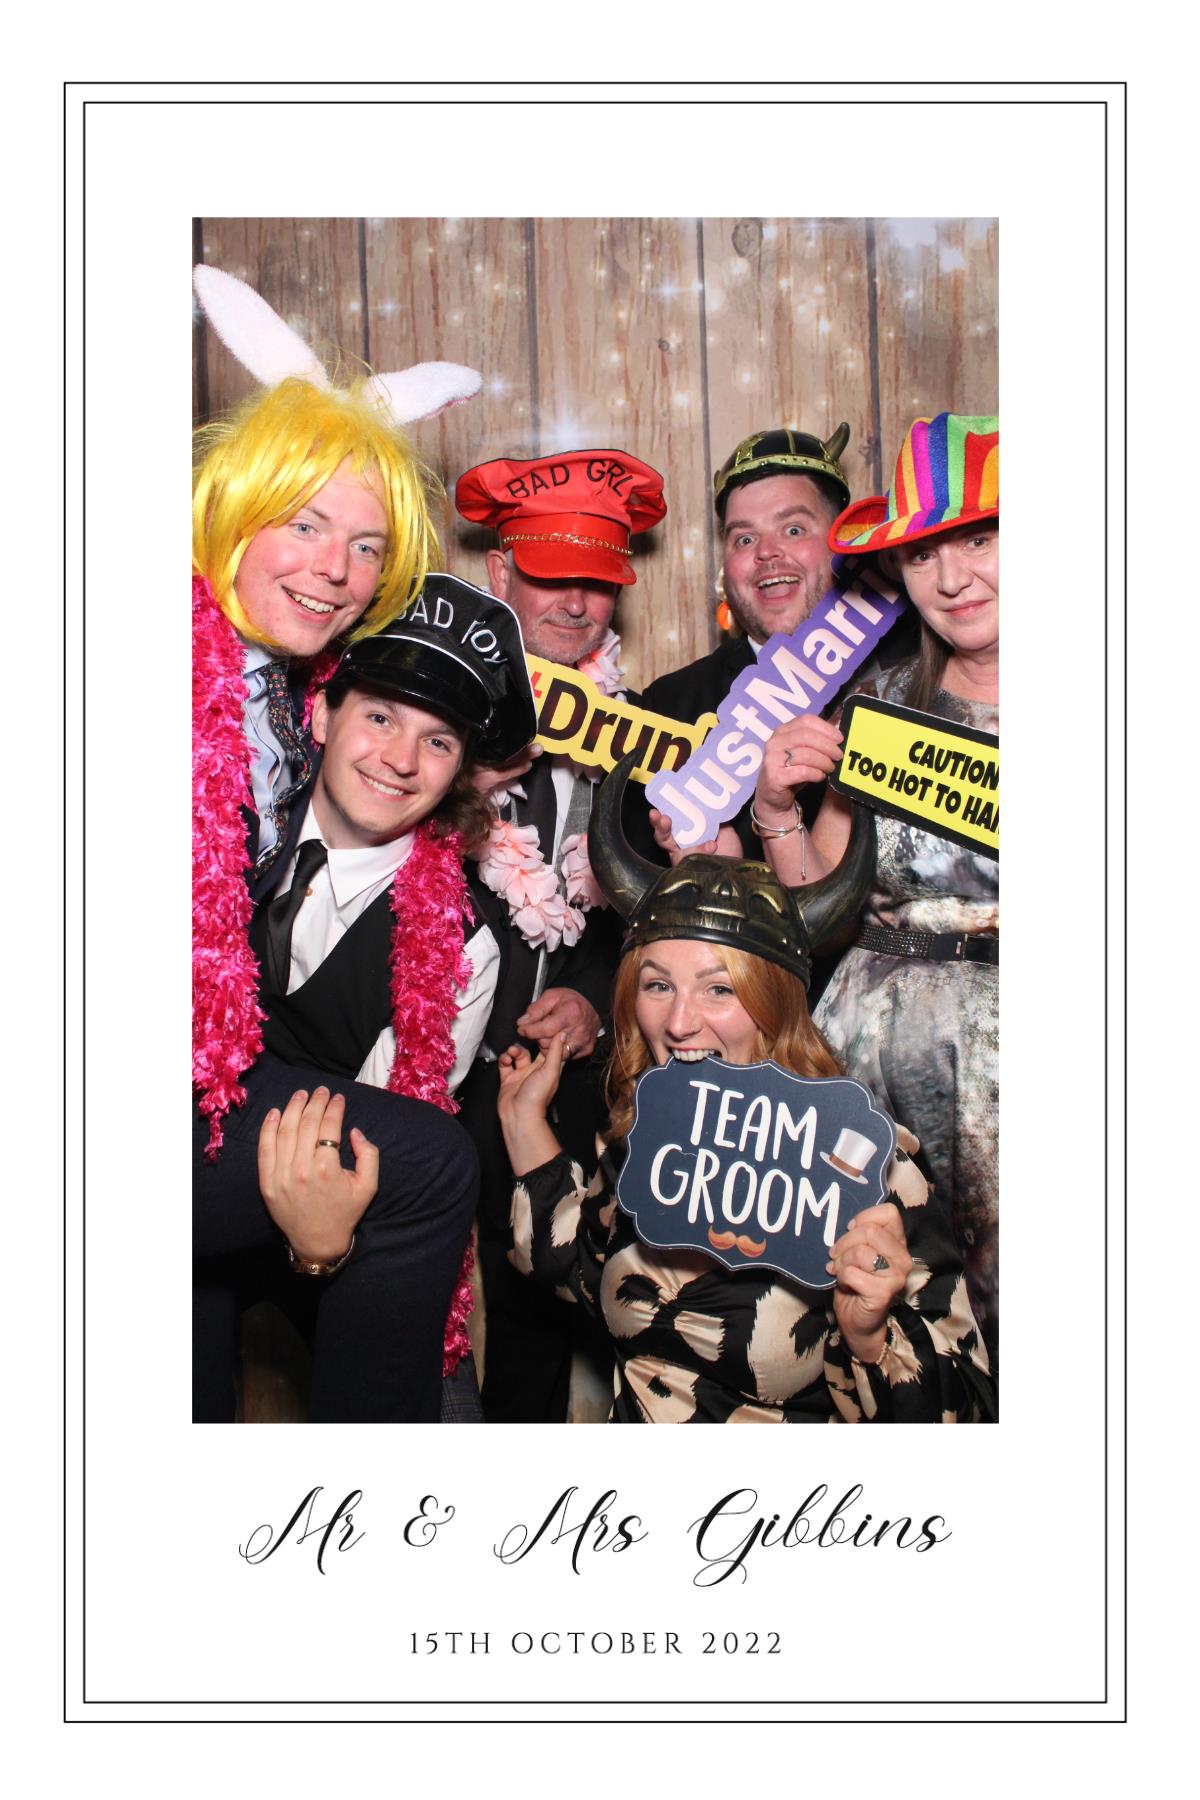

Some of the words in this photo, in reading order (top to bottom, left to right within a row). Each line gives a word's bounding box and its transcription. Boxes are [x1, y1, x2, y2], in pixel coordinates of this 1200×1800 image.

[506, 464, 570, 498] BAD
[587, 459, 634, 497] GRL
[530, 671, 713, 773] Drun
[848, 749, 887, 782] TOO
[888, 766, 934, 801] HOT
[934, 783, 962, 814] TO
[908, 741, 999, 790] CAUTION
[689, 1080, 817, 1170] TEAM
[650, 1143, 840, 1247] GROOM
